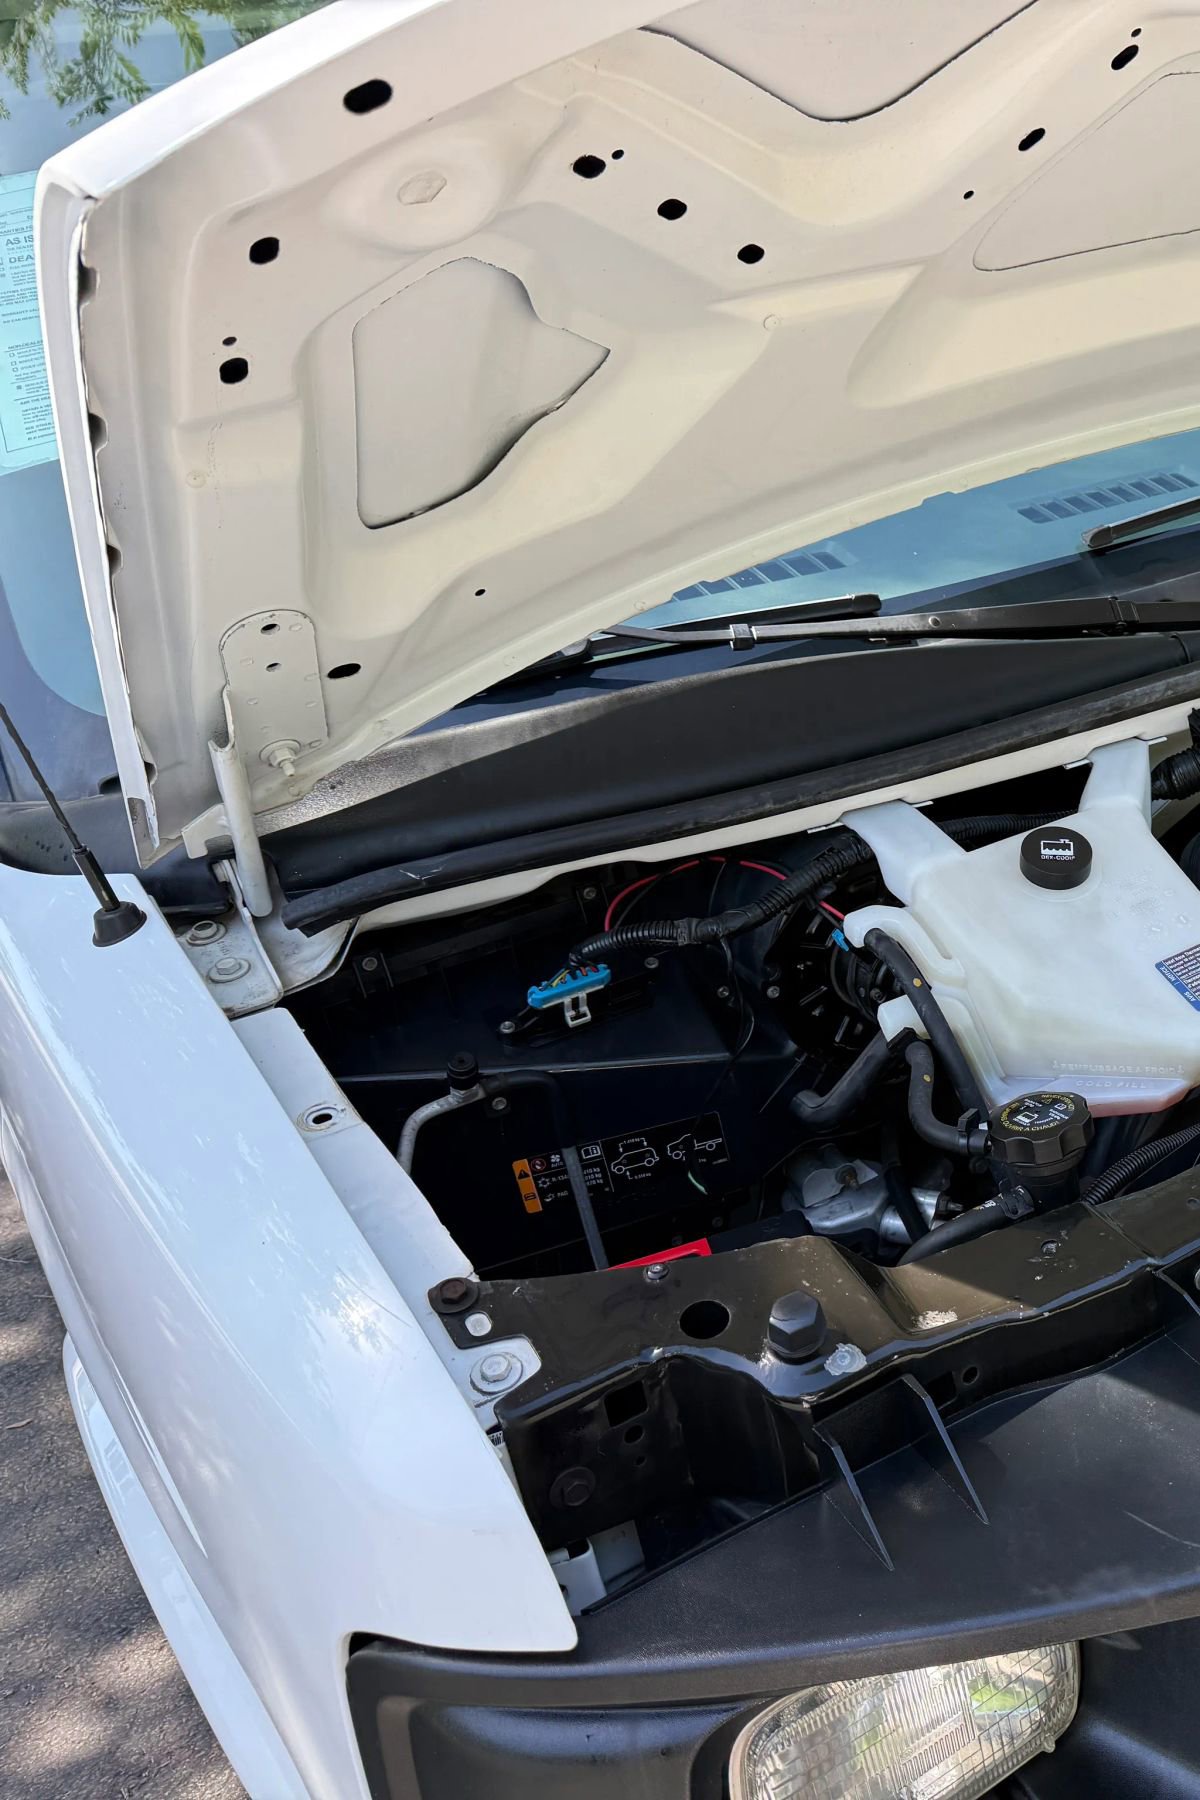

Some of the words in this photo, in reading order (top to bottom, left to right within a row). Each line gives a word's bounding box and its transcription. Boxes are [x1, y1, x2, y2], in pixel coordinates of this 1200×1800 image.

[5, 237, 21, 247] AS
[8, 254, 35, 264] DEA
[1075, 1080, 1112, 1088] COLD
